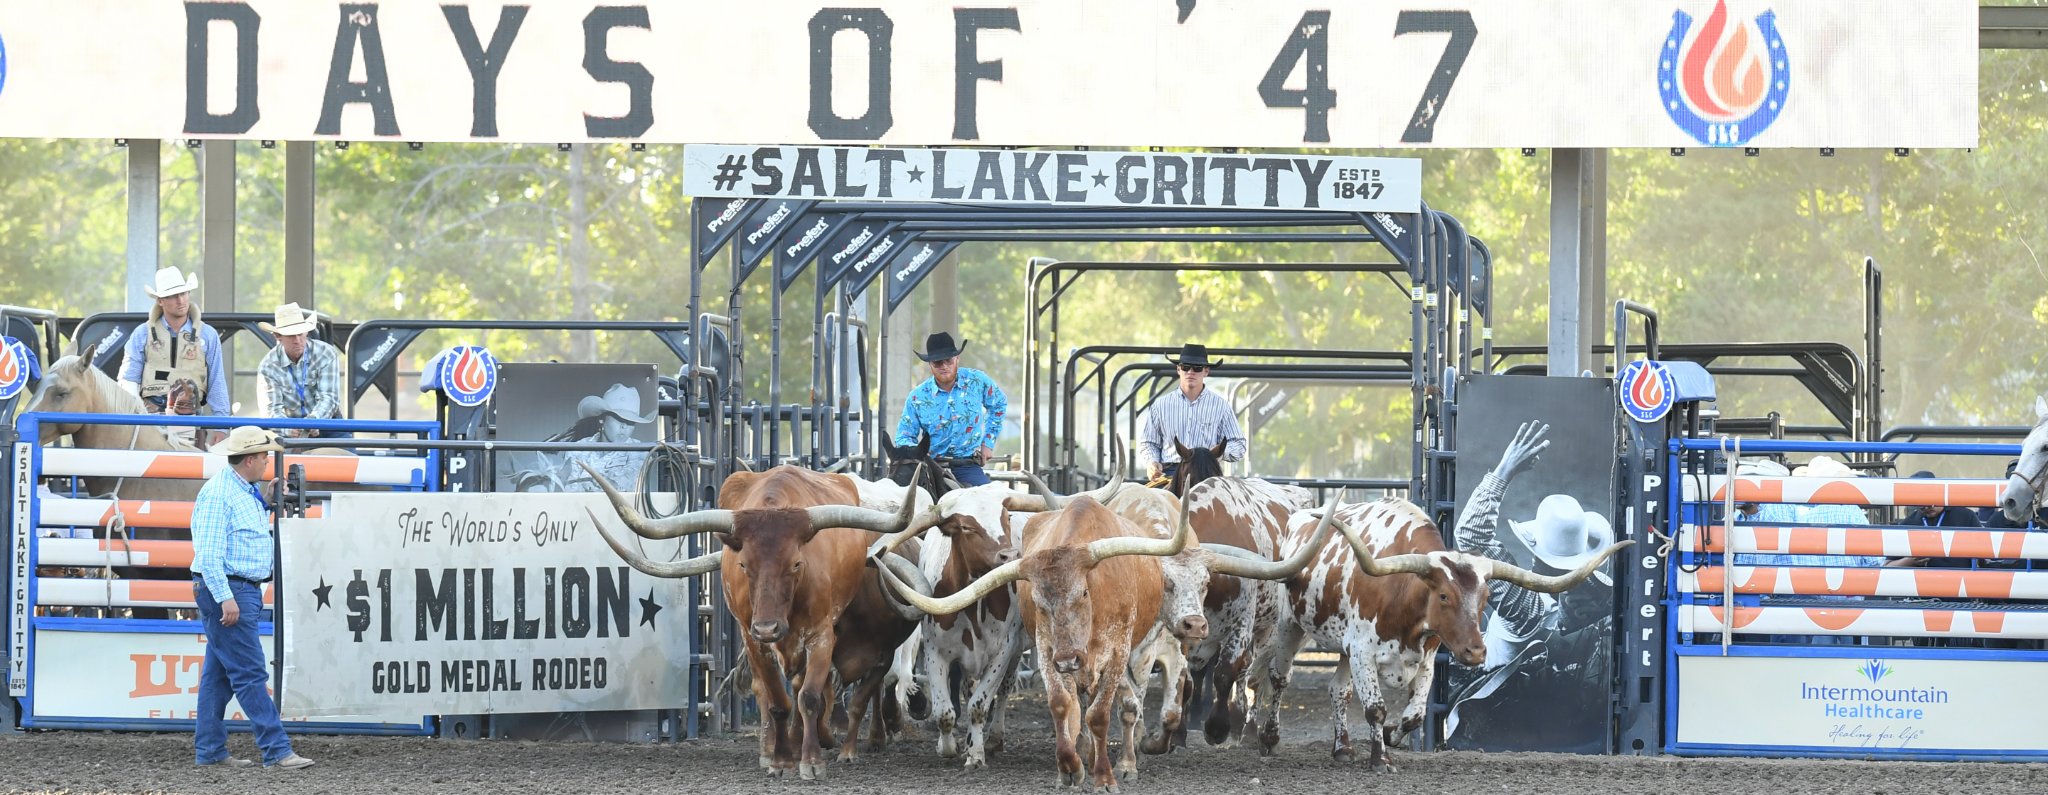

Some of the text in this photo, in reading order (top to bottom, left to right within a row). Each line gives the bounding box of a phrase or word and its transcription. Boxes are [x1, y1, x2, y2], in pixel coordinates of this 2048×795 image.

[183, 1, 655, 138] DAYS
[807, 7, 1022, 141] OF
[713, 147, 1333, 208] #SALT LAKE GRITTY
[1333, 182, 1385, 200] 1847
[747, 204, 790, 245] Priefert
[787, 219, 828, 257] Priefert
[832, 228, 872, 264] Priefert
[94, 326, 123, 358] riefert
[1640, 474, 1662, 667] Priefert
[346, 566, 630, 642] $1 MILLION
[372, 656, 608, 694] GOLD MEDAL RODEO
[1801, 682, 1948, 704] Intermountain
[1825, 703, 1924, 720] Healthcare
[1828, 724, 1872, 747] Healing
[1875, 726, 1893, 748] for
